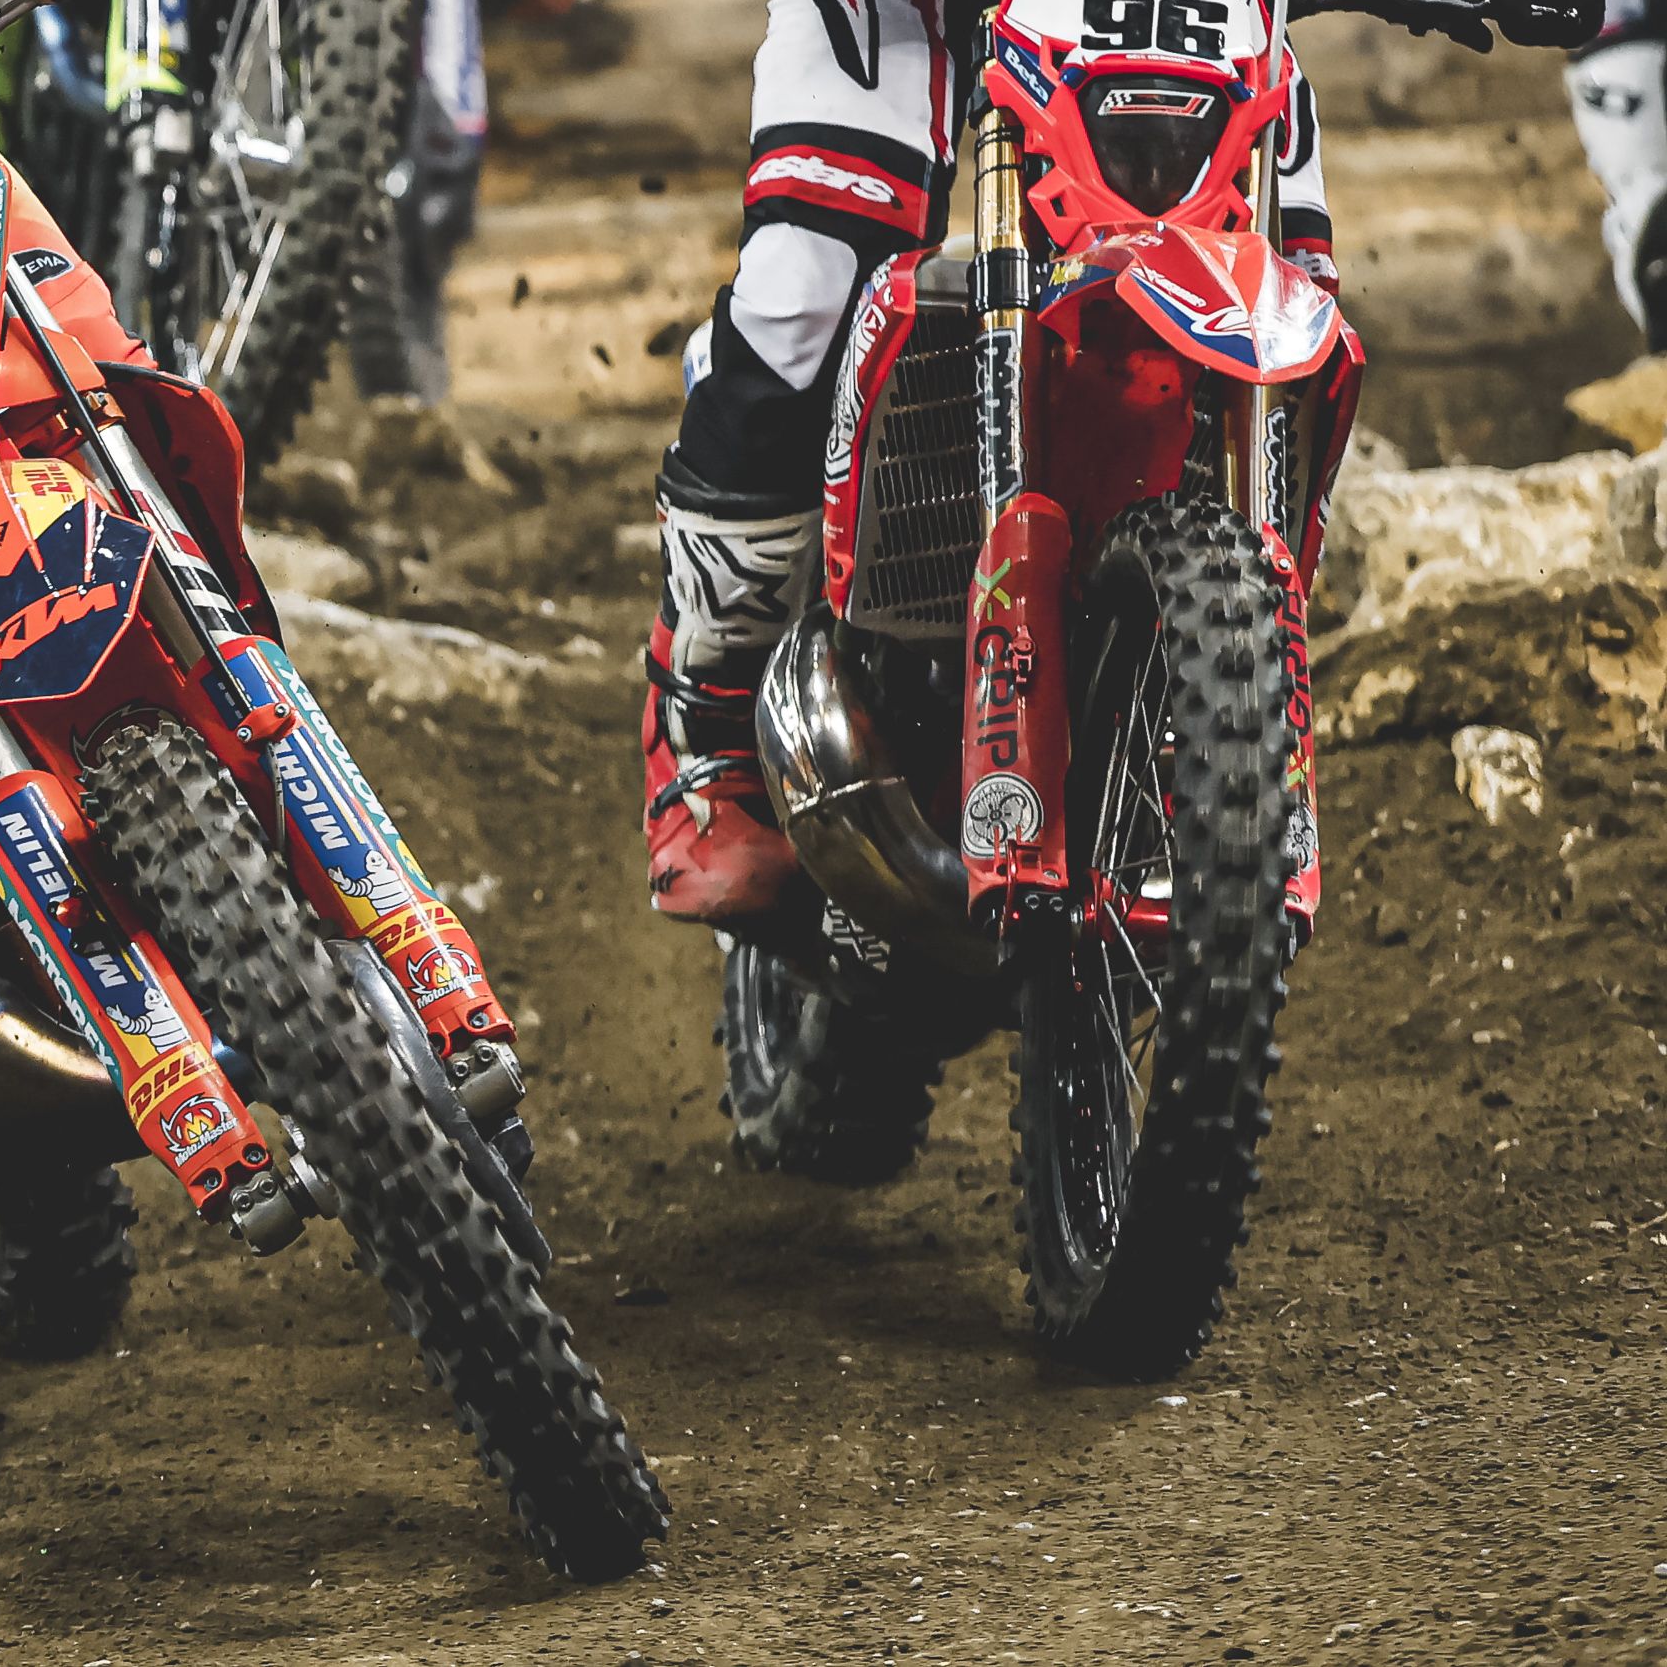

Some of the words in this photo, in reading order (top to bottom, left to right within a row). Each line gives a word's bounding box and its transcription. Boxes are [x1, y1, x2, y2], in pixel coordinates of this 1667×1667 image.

[1004, 45, 1050, 108] Beta
[282, 665, 395, 838] MOTOREX
[377, 907, 455, 961] DHL
[7, 896, 111, 1071] MOTOREX
[131, 1054, 209, 1112] DHL
